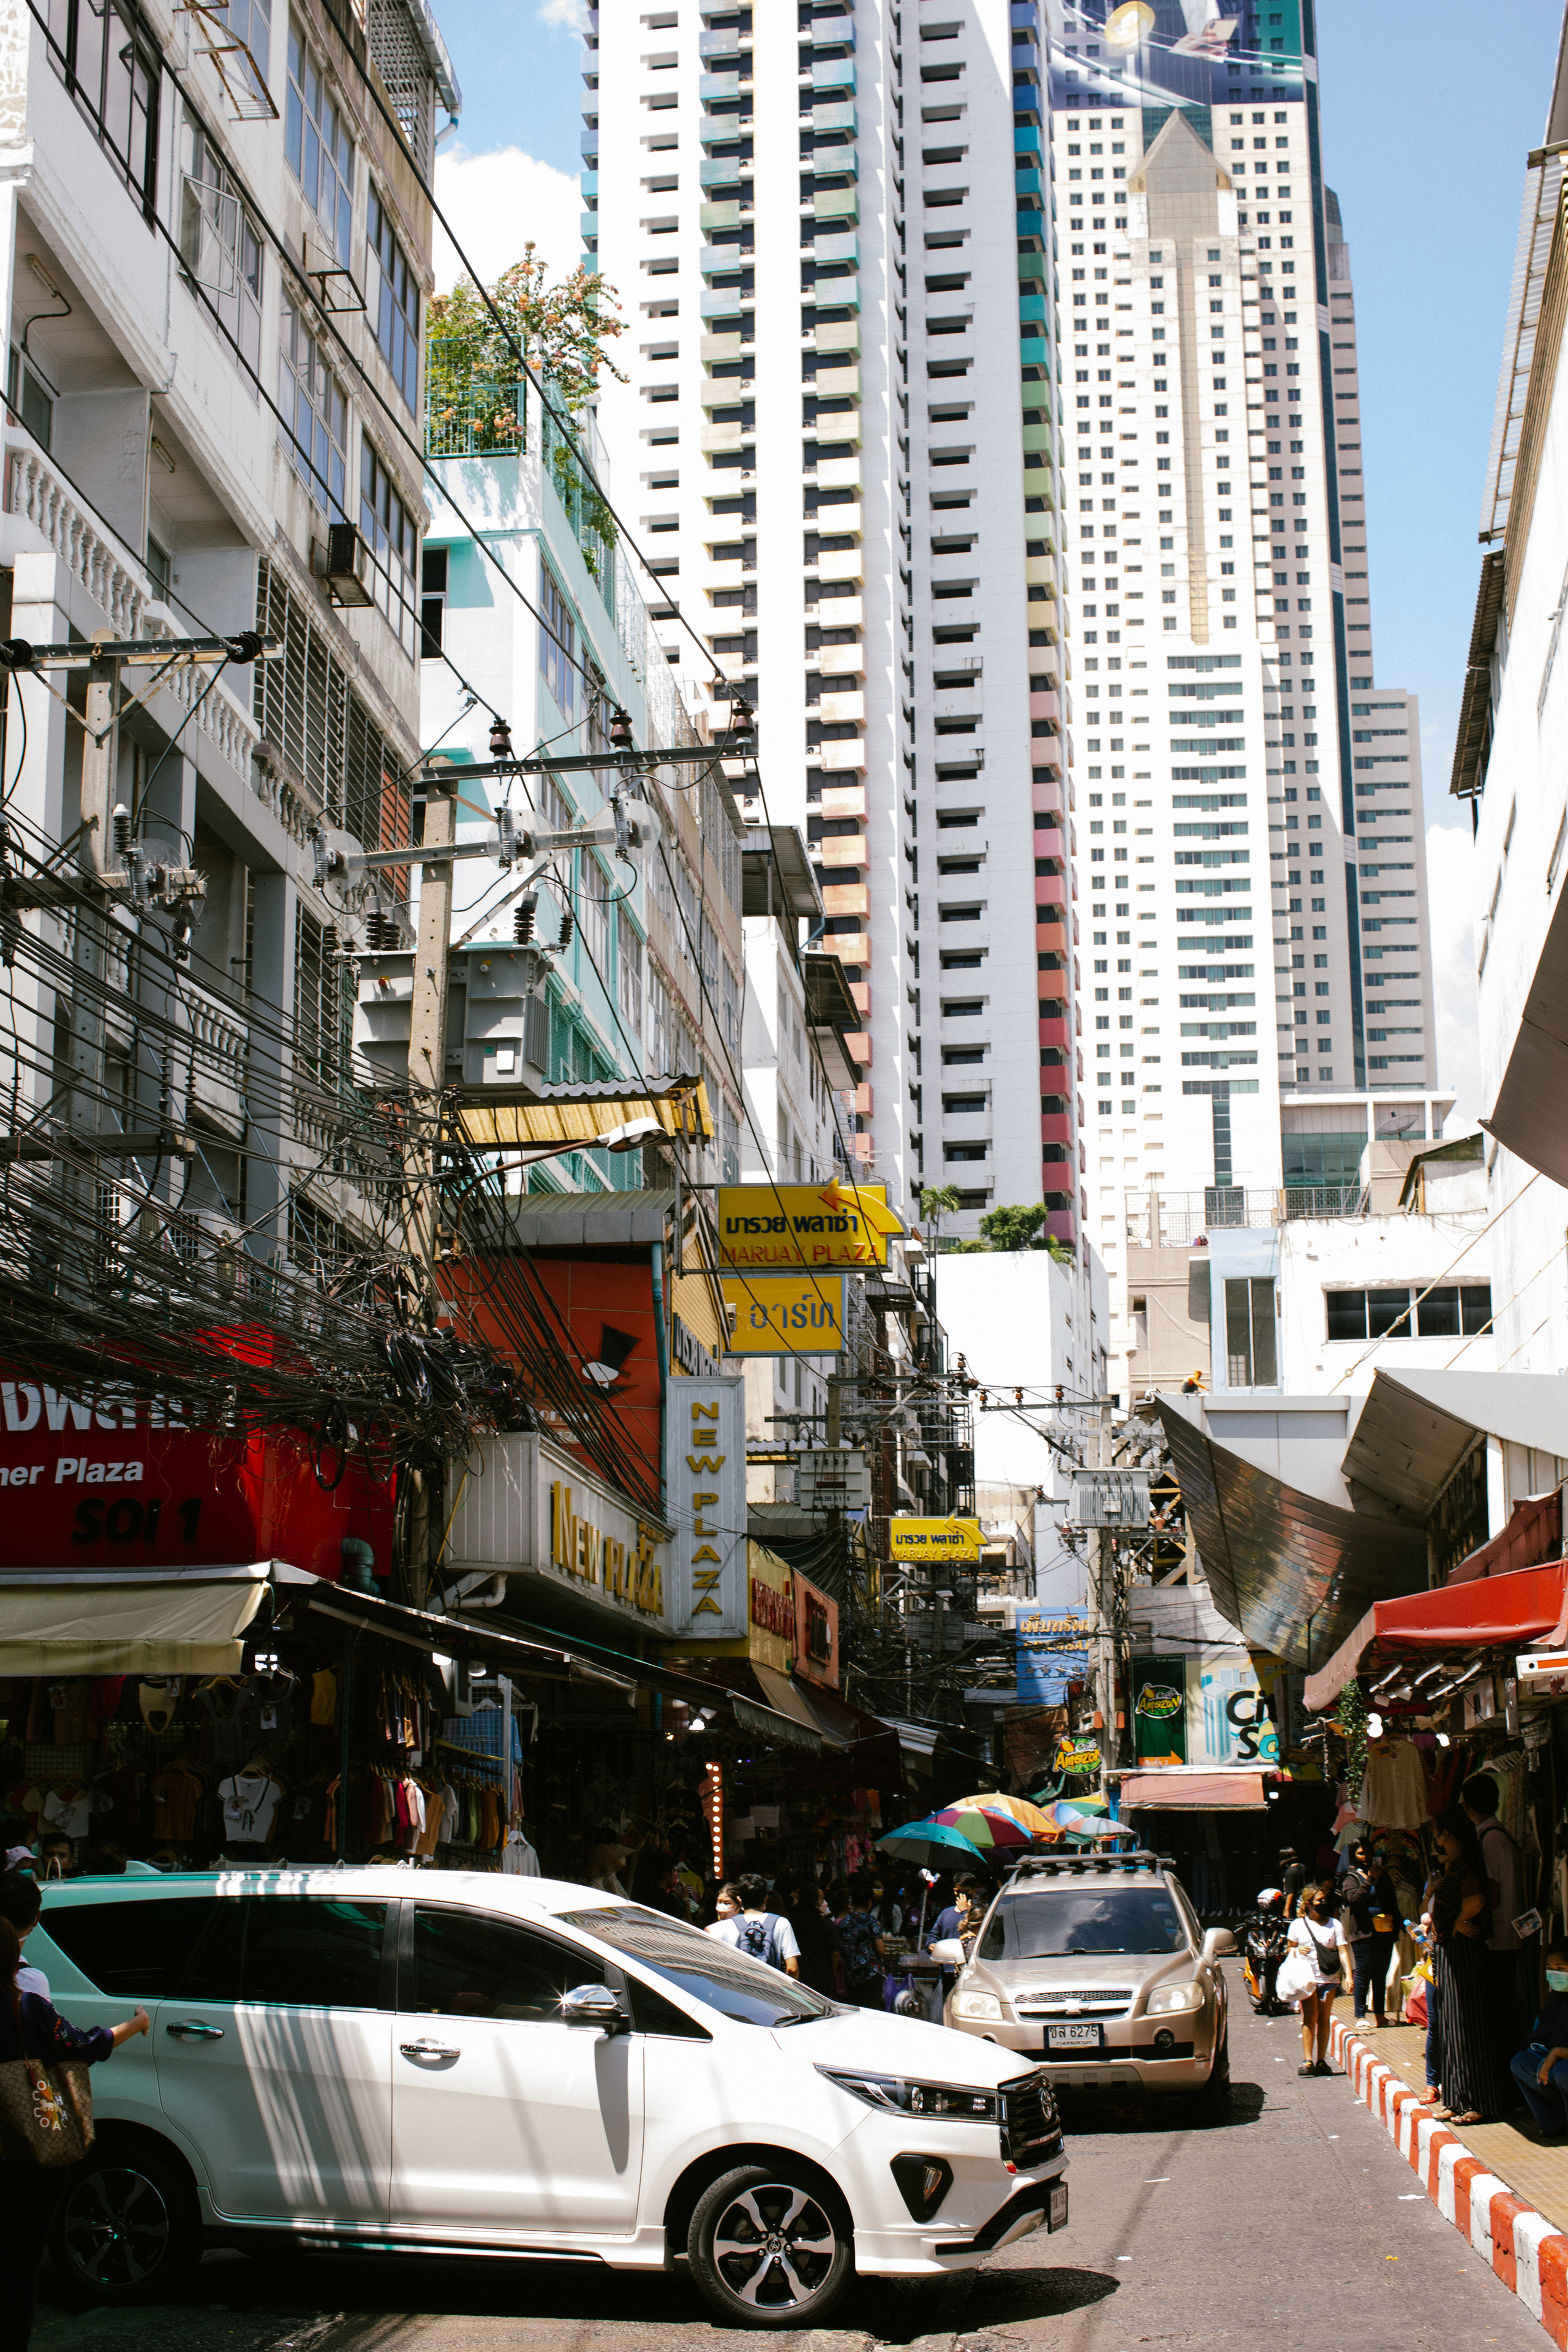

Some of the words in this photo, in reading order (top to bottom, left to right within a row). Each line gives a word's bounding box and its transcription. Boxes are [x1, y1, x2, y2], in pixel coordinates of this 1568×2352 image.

[726, 1215, 786, 1234] มารวย
[793, 1207, 858, 1232] พลาซ่า
[722, 1243, 807, 1262] MARUAY
[813, 1242, 881, 1261] PLAZA
[685, 1401, 726, 1473] NEW
[55, 1457, 145, 1484] Plaza
[71, 1498, 162, 1542] SOI
[178, 1498, 202, 1542] 1
[895, 1534, 927, 1544] มารวย
[691, 1492, 723, 1614] PLAZA
[892, 1547, 937, 1560] MARUAY
[940, 1547, 976, 1560] PLAZA
[1070, 2024, 1098, 2038] 6275
